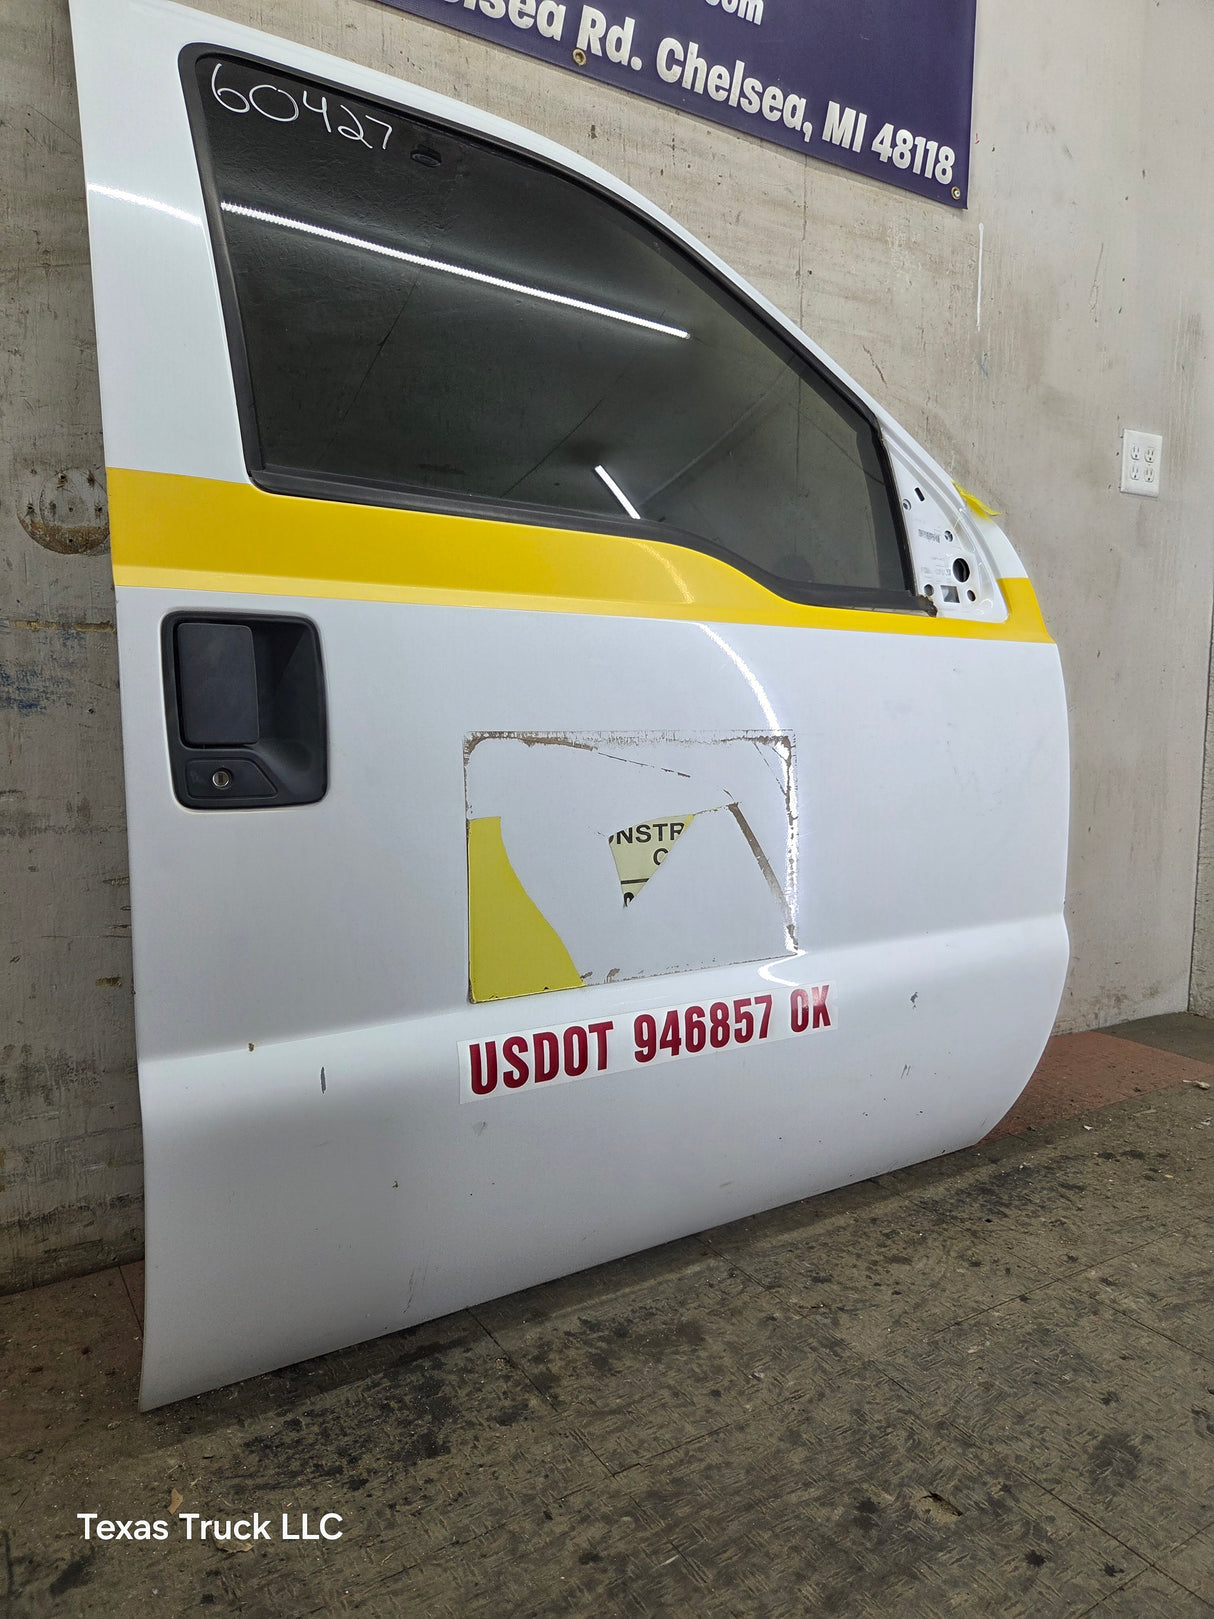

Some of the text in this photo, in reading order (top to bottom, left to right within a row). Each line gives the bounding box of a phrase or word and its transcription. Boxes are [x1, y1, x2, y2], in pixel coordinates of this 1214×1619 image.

[211, 63, 392, 150] 60427
[576, 4, 643, 71] Rd.
[656, 37, 813, 142] Chelsea,
[822, 101, 867, 153] MI
[871, 123, 955, 184] 48118
[608, 822, 685, 845] NSTR
[469, 984, 833, 1096] USDOT 946857 OK
